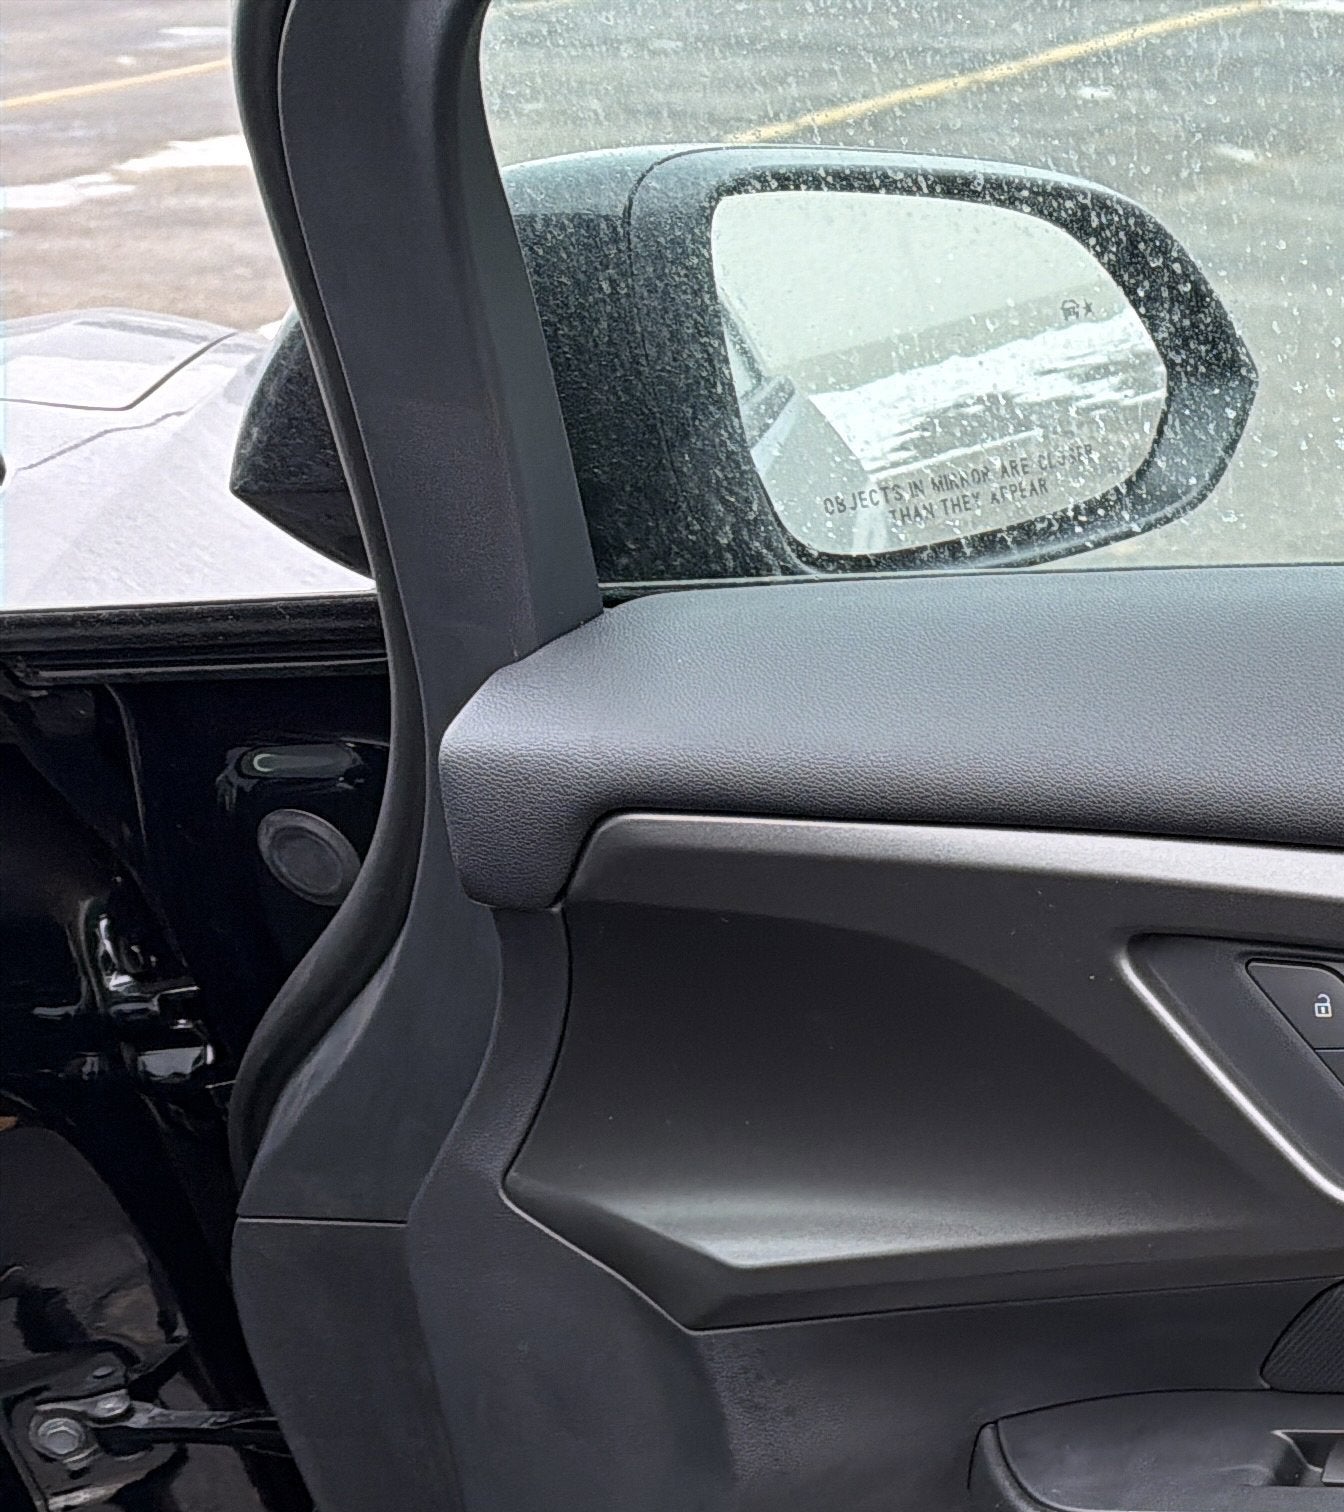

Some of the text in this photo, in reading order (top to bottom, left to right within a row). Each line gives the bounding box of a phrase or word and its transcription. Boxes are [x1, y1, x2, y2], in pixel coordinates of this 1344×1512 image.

[823, 444, 1096, 515] OBJECTS IN MIRROR ARE CLOSER
[887, 478, 1049, 526] THAN THEY APPEAR
